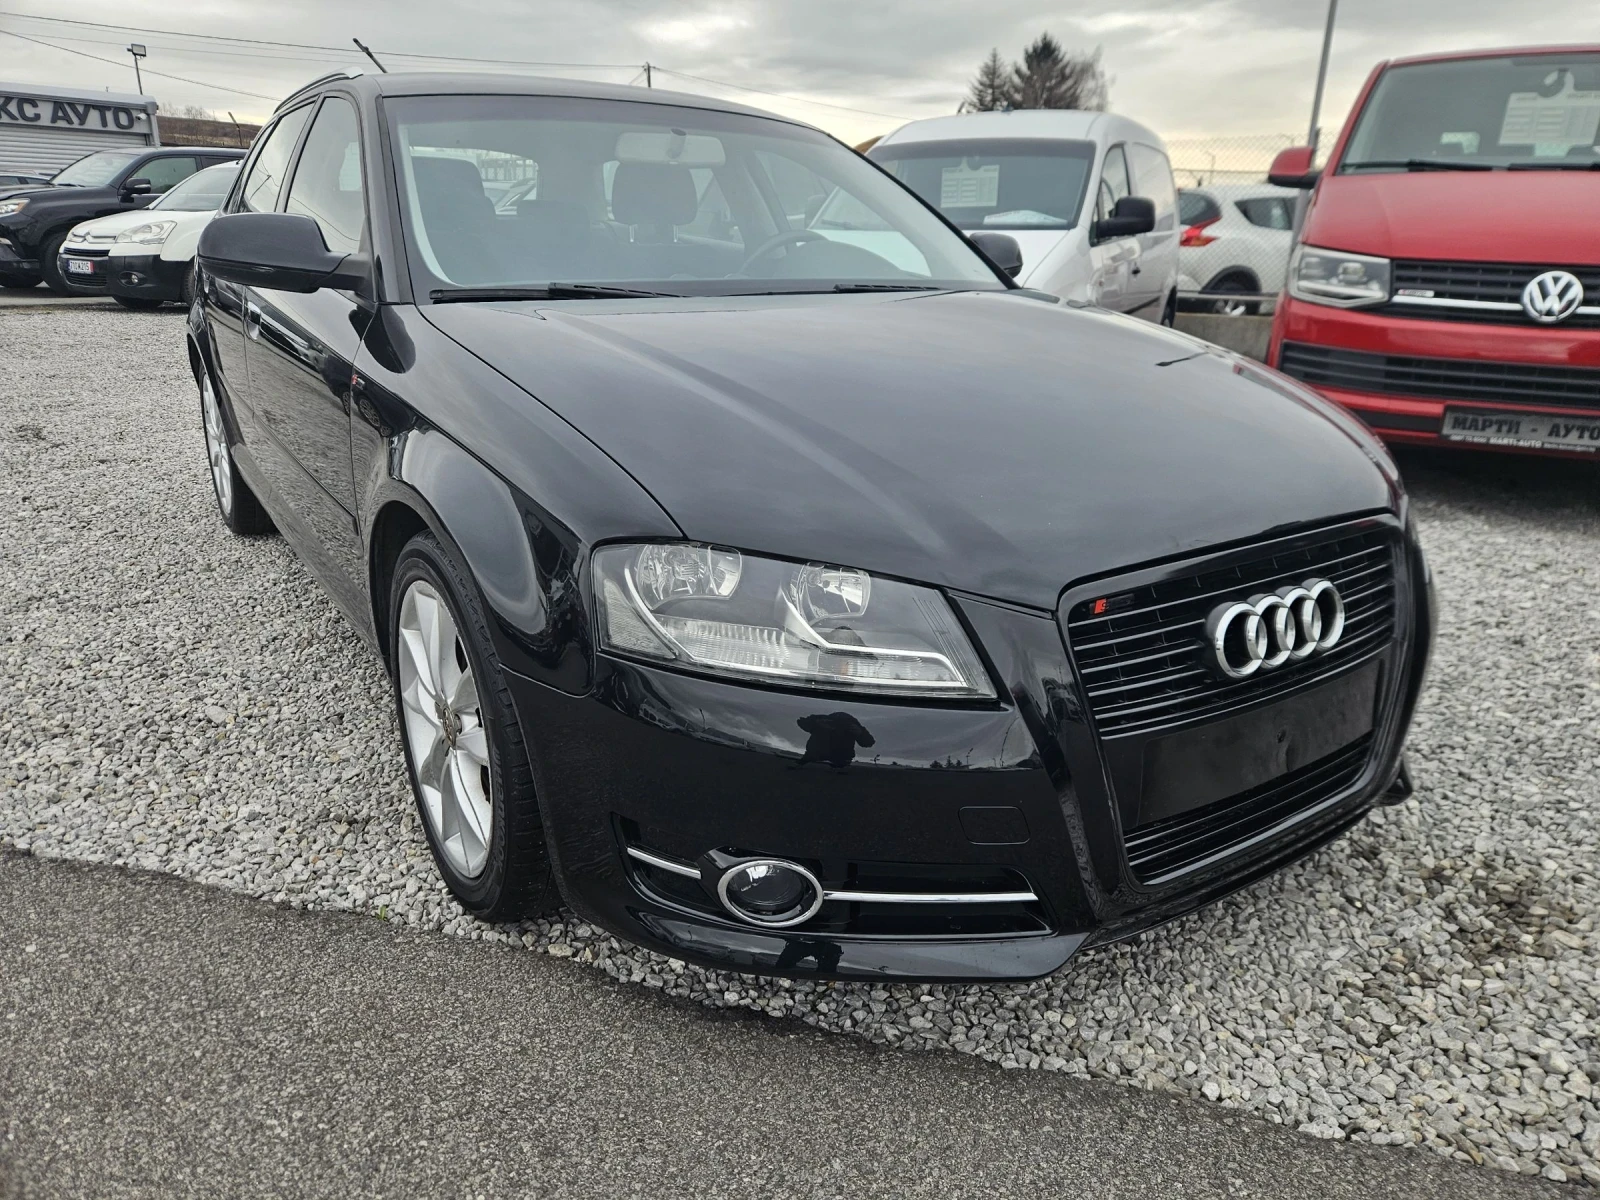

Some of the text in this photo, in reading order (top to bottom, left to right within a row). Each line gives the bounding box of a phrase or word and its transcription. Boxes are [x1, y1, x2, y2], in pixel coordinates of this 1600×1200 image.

[50, 101, 135, 130] АУТО
[1524, 270, 1584, 322] VW
[1548, 422, 1600, 441] АУТО
